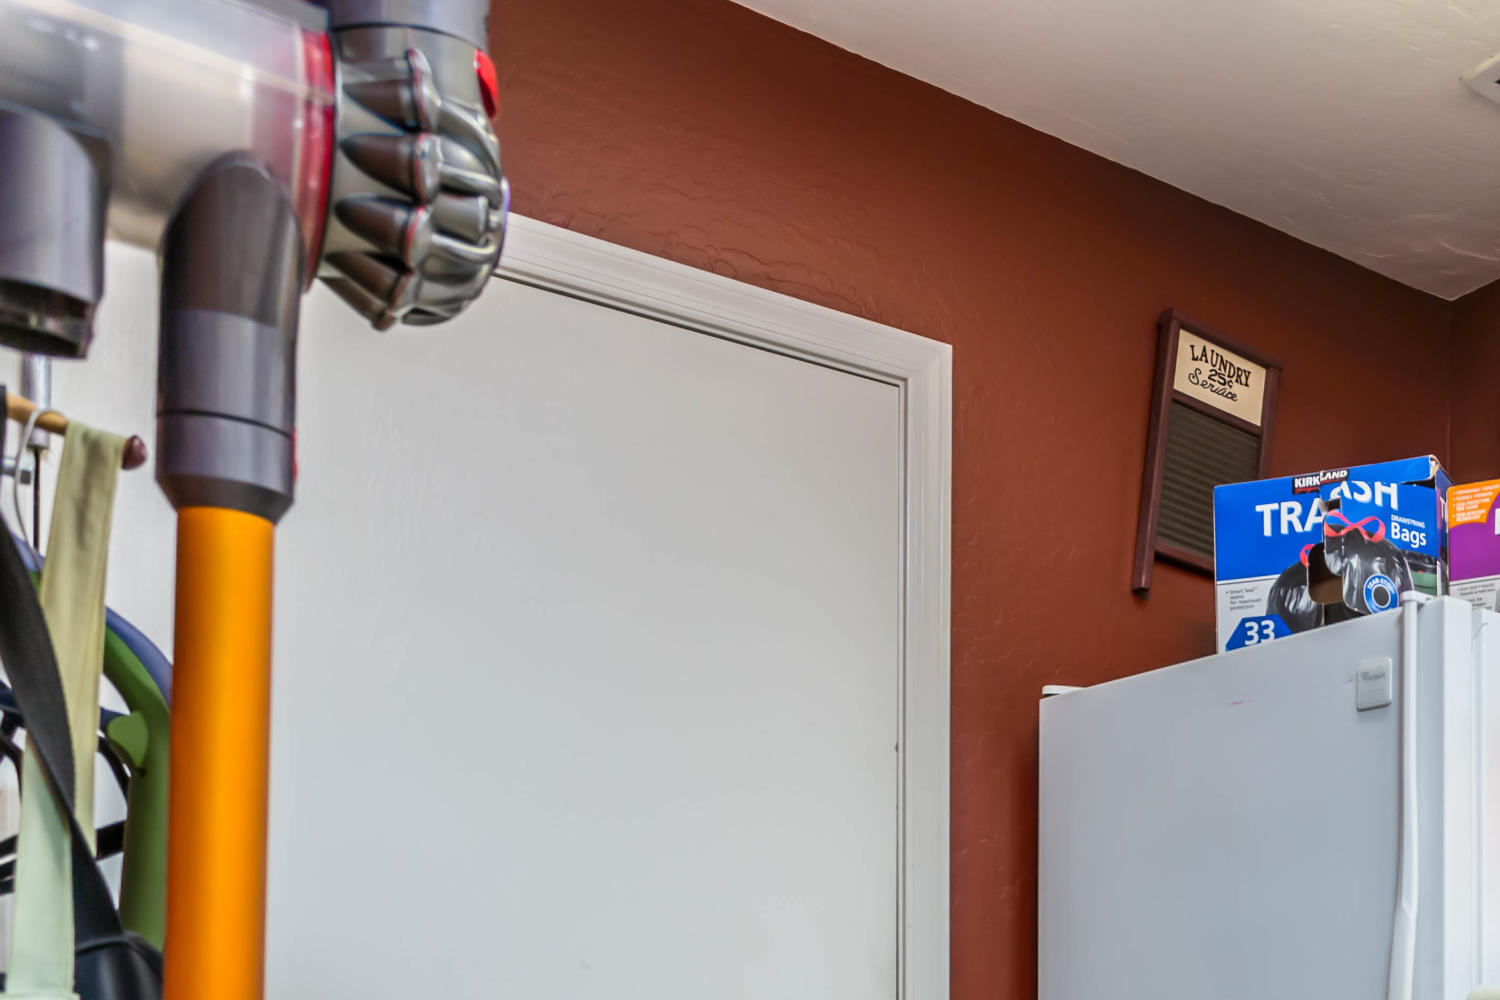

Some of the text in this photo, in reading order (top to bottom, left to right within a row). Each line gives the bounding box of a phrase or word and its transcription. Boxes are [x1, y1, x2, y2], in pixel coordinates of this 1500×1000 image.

[1190, 344, 1251, 387] LAUNDRY
[1187, 368, 1238, 402] Service
[1294, 470, 1348, 489] KIRKLAND
[1255, 480, 1399, 537] TRASH
[1391, 522, 1427, 549] Bags
[1244, 620, 1275, 646] 33
